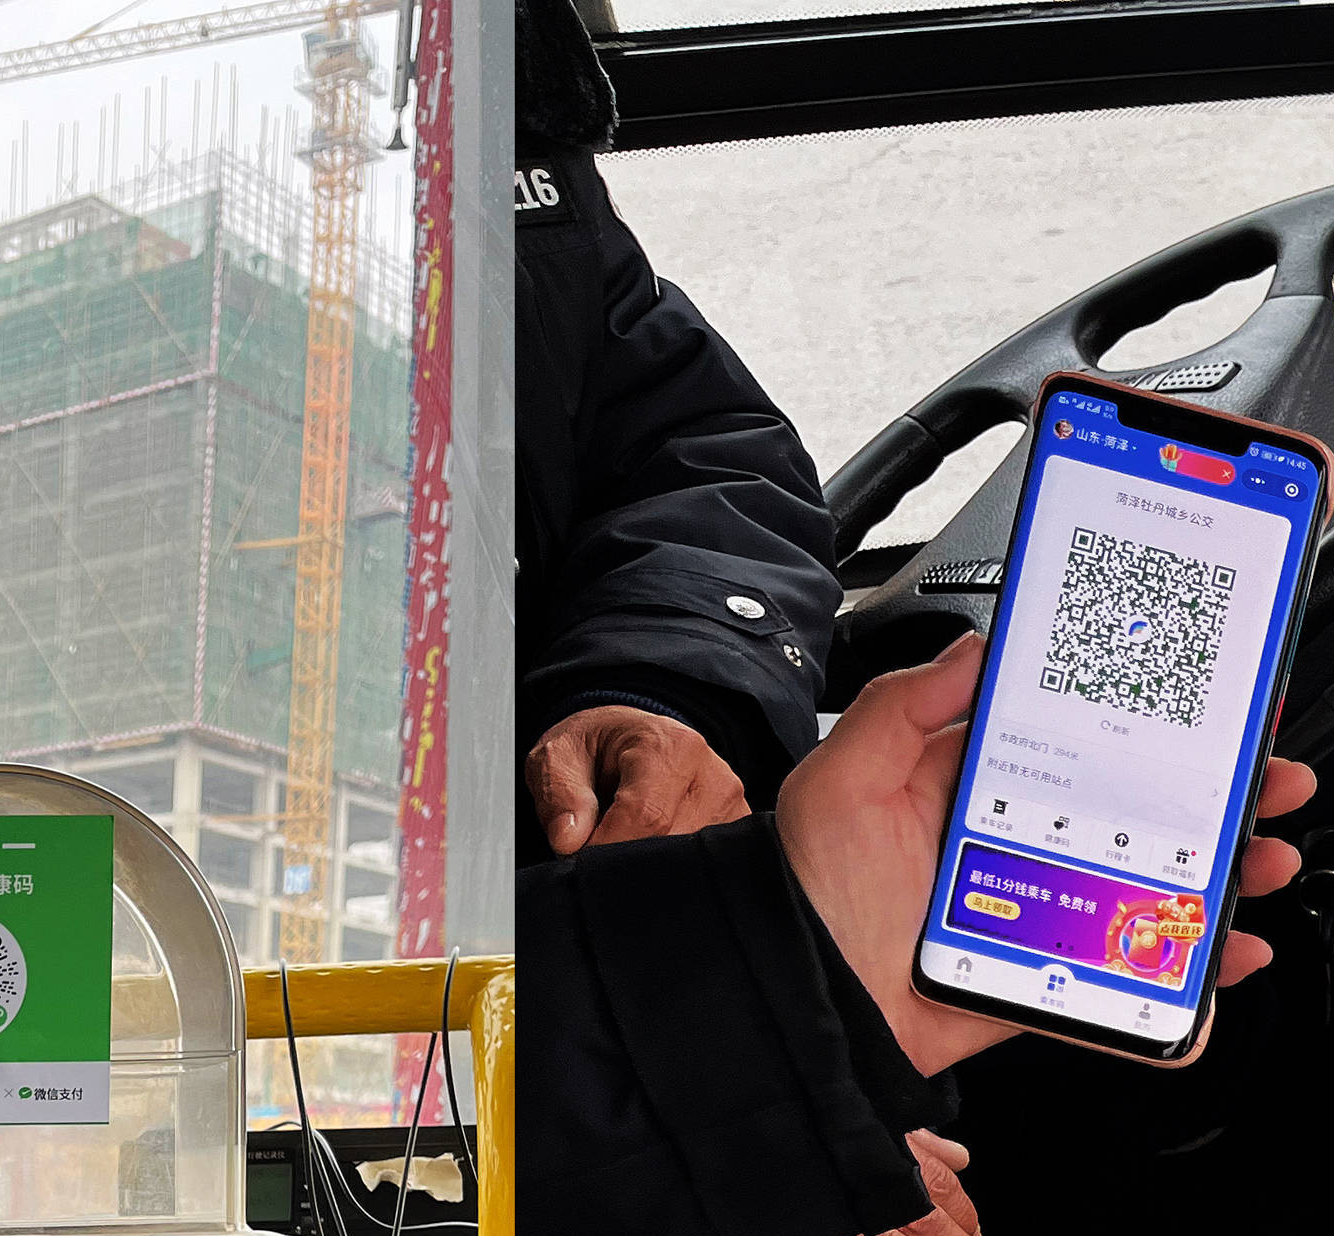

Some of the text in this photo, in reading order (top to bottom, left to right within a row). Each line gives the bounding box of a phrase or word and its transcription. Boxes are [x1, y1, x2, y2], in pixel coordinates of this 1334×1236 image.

[1116, 492, 1214, 529] 菏泽牡丹城乡公交
[986, 756, 1072, 789] 附近暂无可用站点
[969, 869, 1053, 903] 最低1分钱乘车
[34, 1087, 83, 1102] 微信支付
